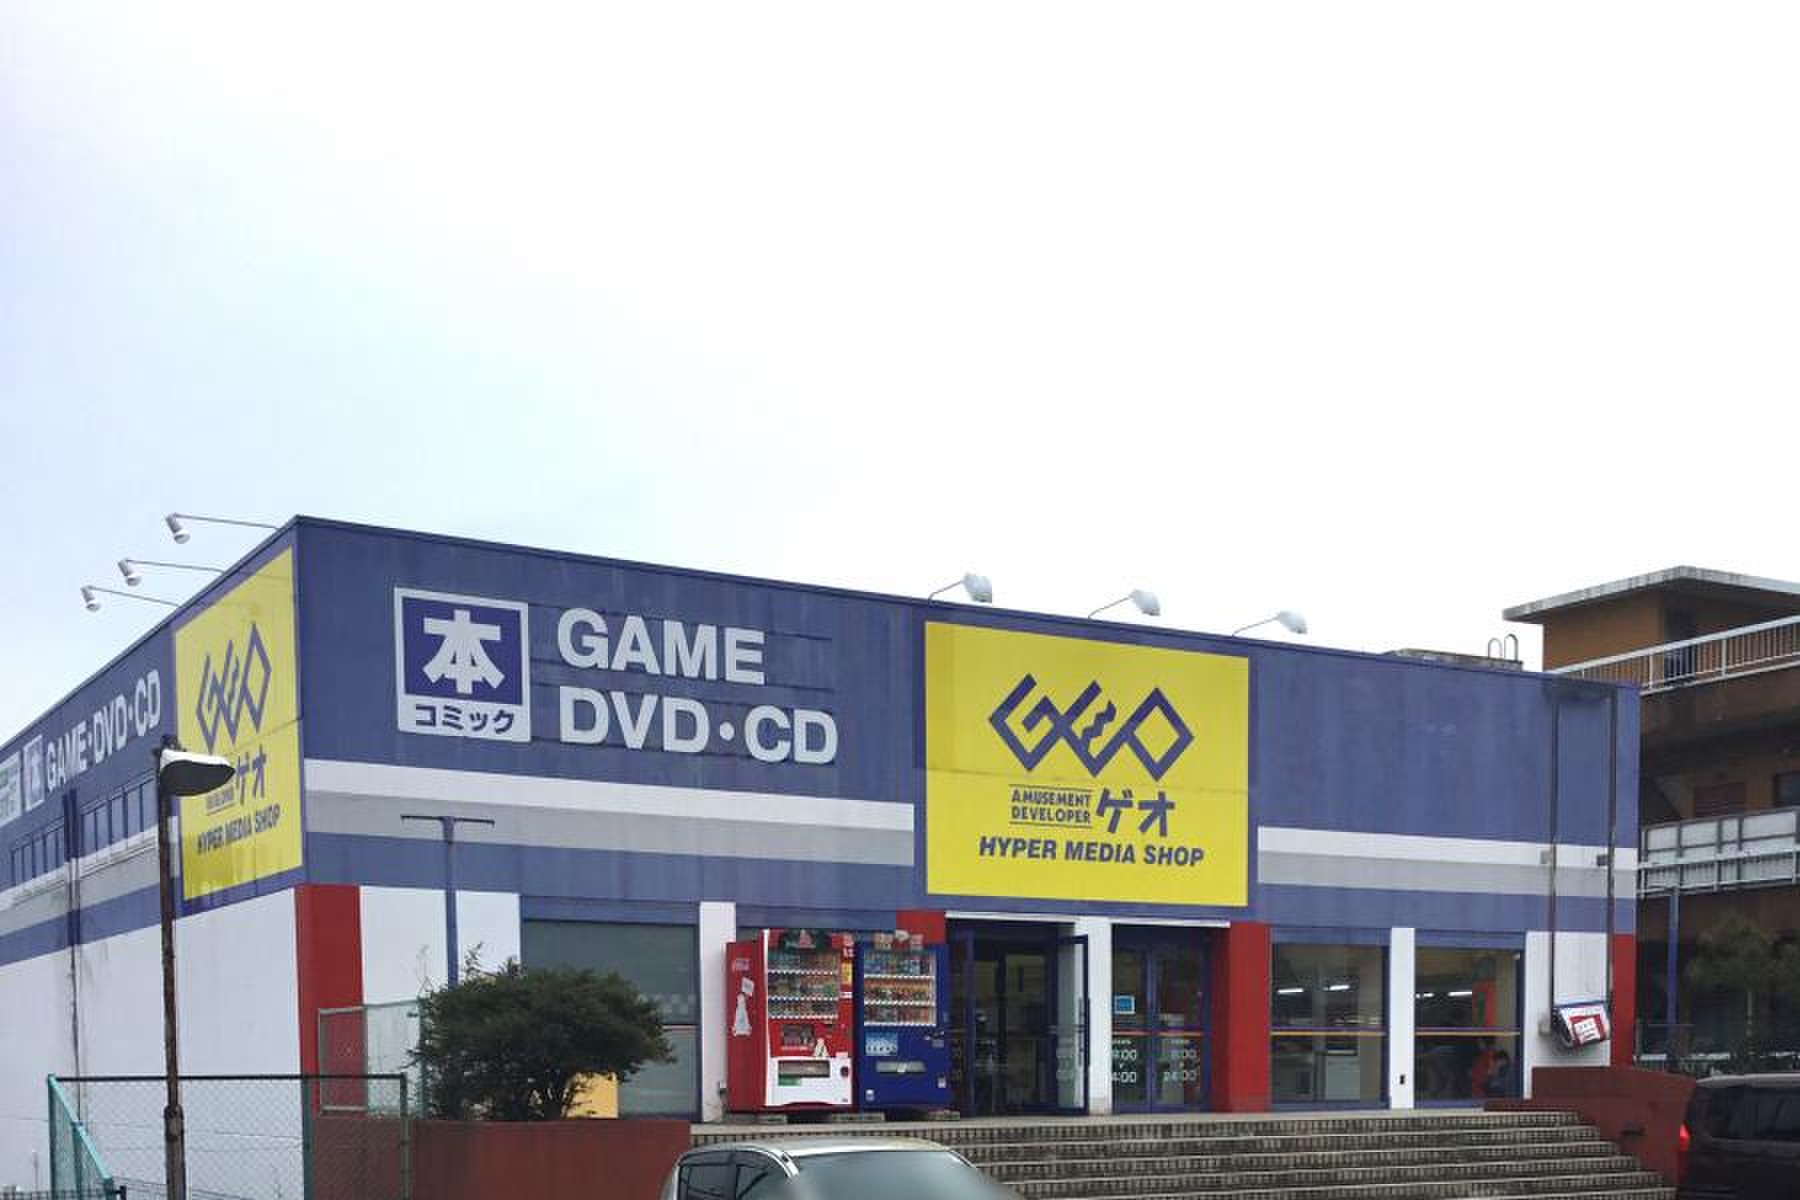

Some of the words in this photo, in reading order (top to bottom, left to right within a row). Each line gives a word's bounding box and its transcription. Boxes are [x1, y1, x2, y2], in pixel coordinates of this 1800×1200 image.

[422, 608, 505, 694] 本
[557, 607, 766, 686] GAME
[415, 704, 515, 735] コミック
[1011, 788, 1091, 809] AMUSEMENT
[1011, 804, 1091, 824] DEVELOPER
[1096, 788, 1175, 837] ゲオ
[979, 835, 1057, 860] HYPER
[1064, 840, 1136, 865] MEDIA
[1143, 846, 1205, 867] SHOP
